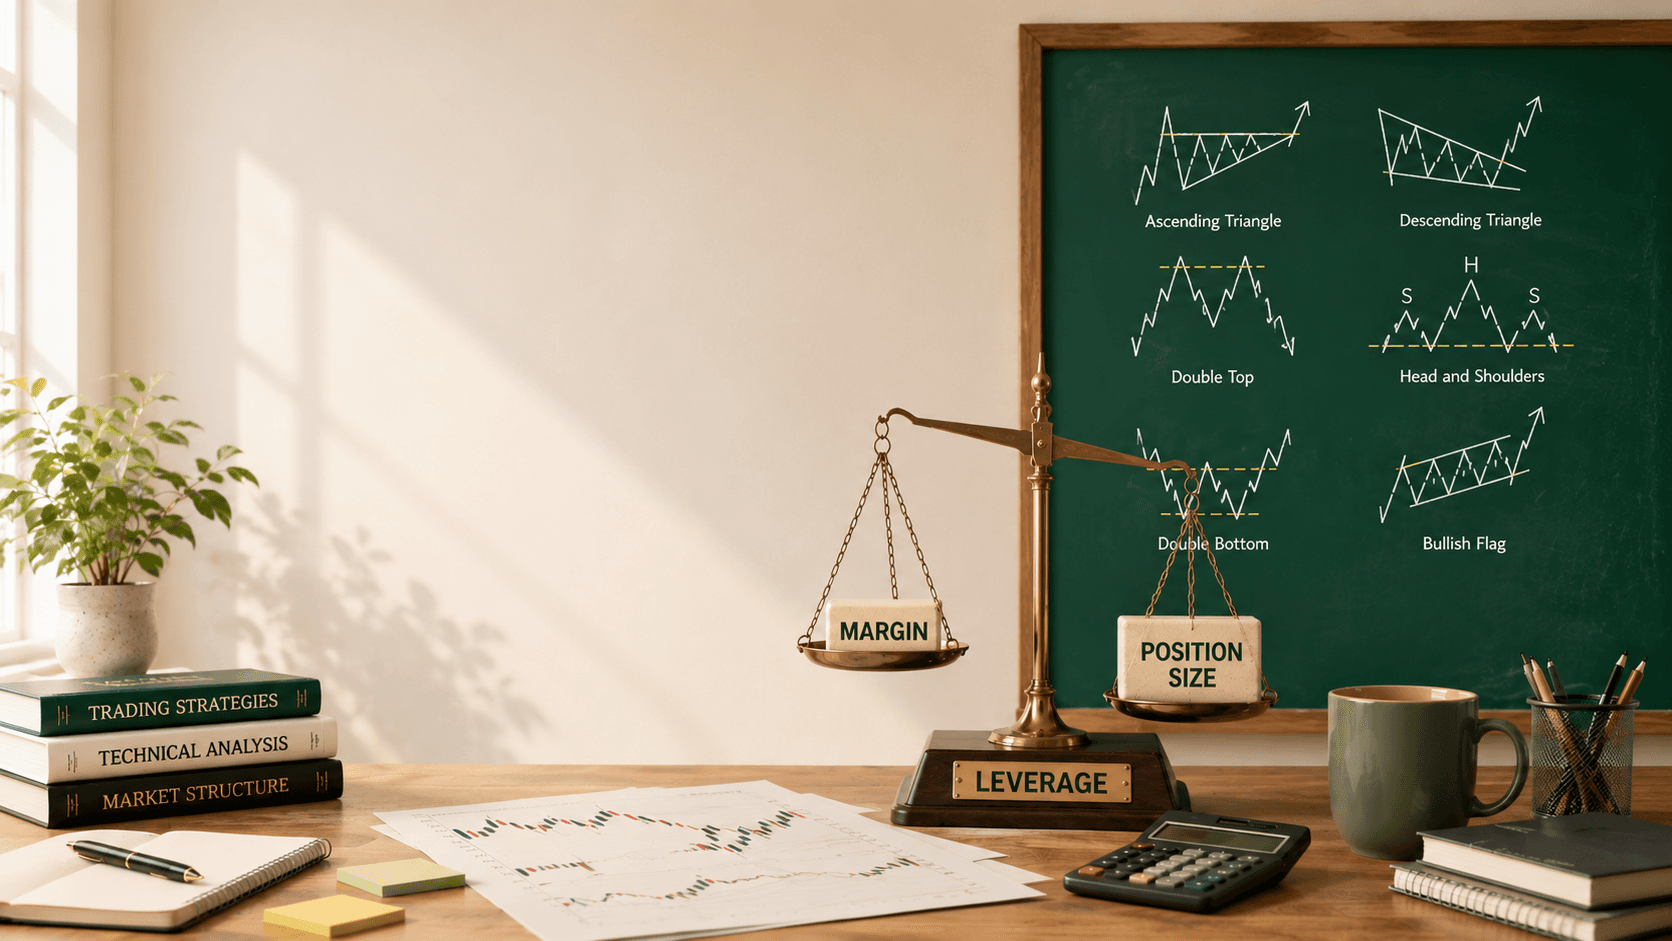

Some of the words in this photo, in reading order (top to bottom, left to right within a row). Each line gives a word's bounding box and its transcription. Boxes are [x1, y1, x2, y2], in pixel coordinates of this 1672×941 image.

[1145, 213, 1220, 231] Ascending
[1225, 213, 1282, 231] Triangle
[1400, 212, 1481, 230] Descending
[1486, 212, 1542, 229] Triangle
[1465, 256, 1479, 273] H
[1401, 287, 1413, 304] S
[1529, 287, 1540, 304] S
[1171, 369, 1222, 383] Double
[1228, 369, 1255, 388] Top
[1400, 368, 1437, 383] Head
[1443, 368, 1470, 383] and
[1475, 368, 1545, 383] Shoulders
[1158, 536, 1209, 551] Double
[1215, 536, 1269, 551] Bottom
[1423, 535, 1470, 551] Bullish
[1477, 535, 1507, 553] Flag
[840, 621, 928, 641] MARGIN
[1141, 641, 1243, 662] POSITION
[1168, 667, 1217, 688] SIZE
[88, 701, 170, 721] TRADING
[176, 694, 278, 715] STRATEGIES
[98, 743, 201, 766] TECHNICAL
[206, 735, 289, 757] ANALYSIS
[976, 770, 1108, 795] LEVERAGE
[102, 787, 180, 810] MARKET
[186, 778, 289, 801] STRUCTURE
